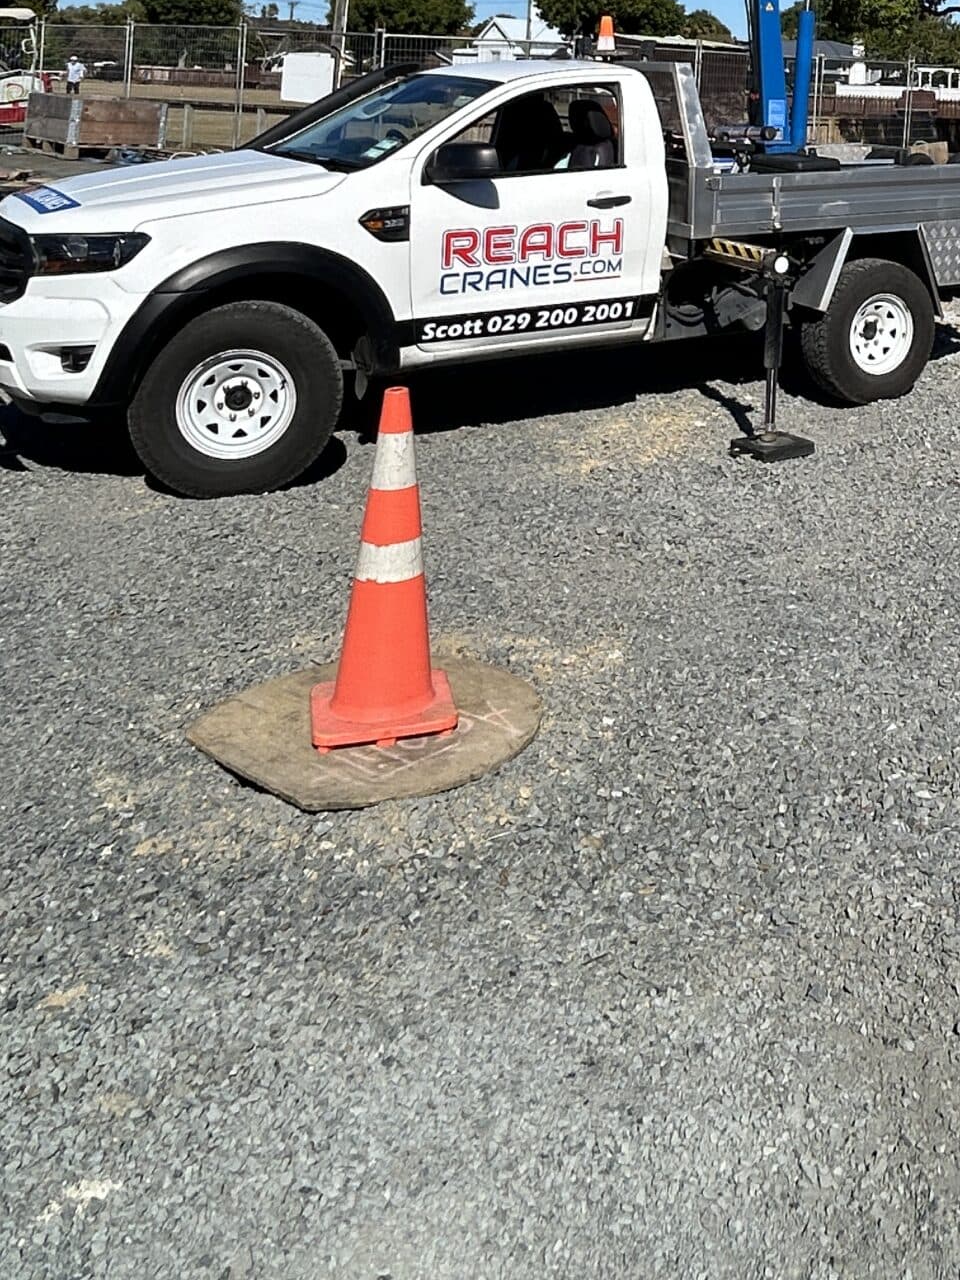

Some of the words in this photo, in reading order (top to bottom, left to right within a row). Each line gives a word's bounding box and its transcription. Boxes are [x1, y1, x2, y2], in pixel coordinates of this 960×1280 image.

[441, 218, 624, 270] REACH
[440, 258, 623, 295] CRANES.COM
[422, 319, 483, 340] Scott
[487, 312, 531, 333] 029
[535, 307, 578, 328] 200
[582, 301, 634, 322] 2001
